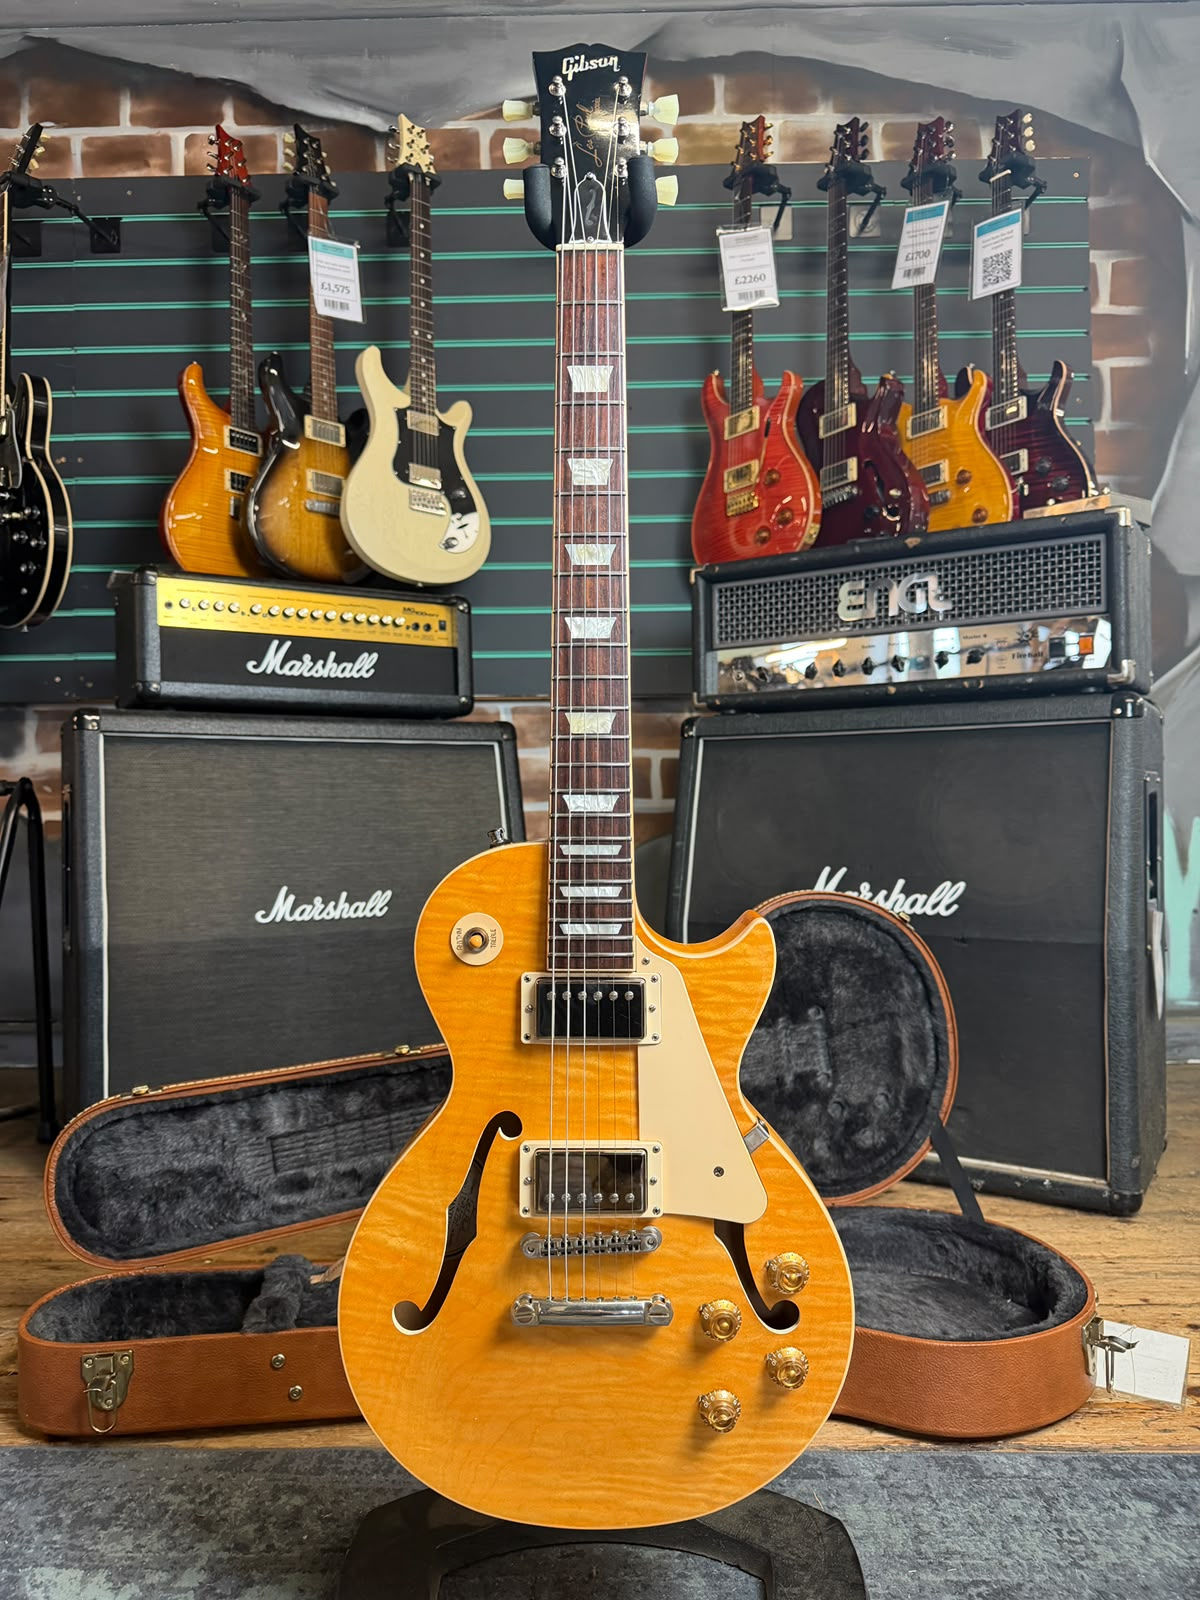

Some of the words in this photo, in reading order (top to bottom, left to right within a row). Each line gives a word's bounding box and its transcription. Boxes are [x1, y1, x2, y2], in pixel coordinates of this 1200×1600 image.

[562, 54, 621, 81] Gibson
[320, 281, 351, 295] £1,575
[735, 272, 767, 286] £2260
[246, 639, 379, 680] Marshall
[254, 885, 393, 924] Marshall
